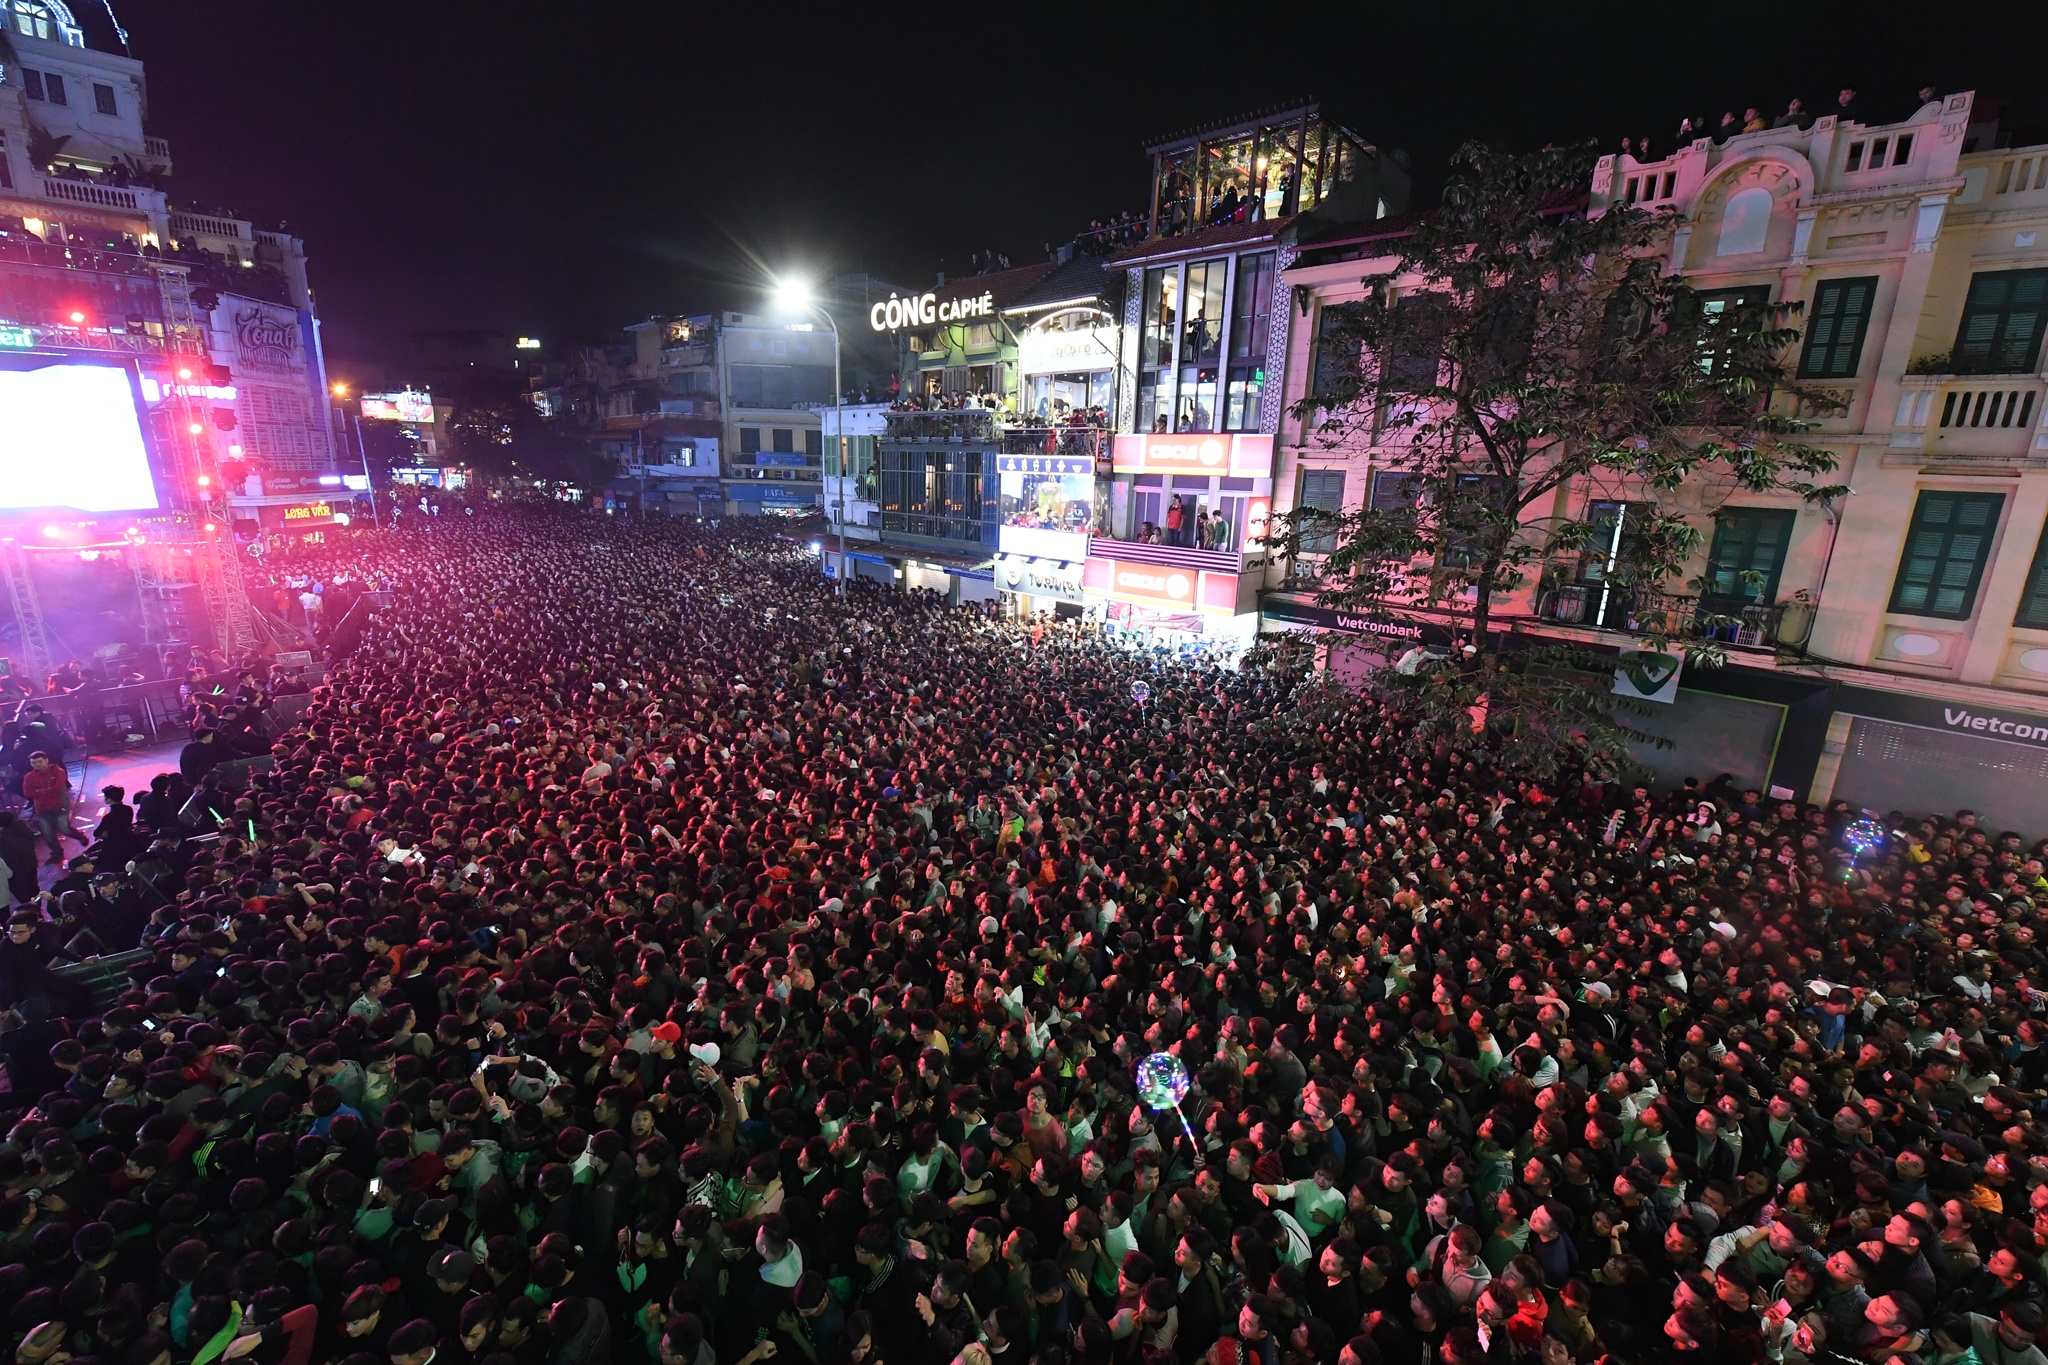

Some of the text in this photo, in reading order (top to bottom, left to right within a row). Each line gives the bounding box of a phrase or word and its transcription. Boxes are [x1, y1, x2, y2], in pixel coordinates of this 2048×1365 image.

[871, 290, 993, 334] CỘNG CÀPHÊ
[1336, 615, 1423, 639] Vietcombank
